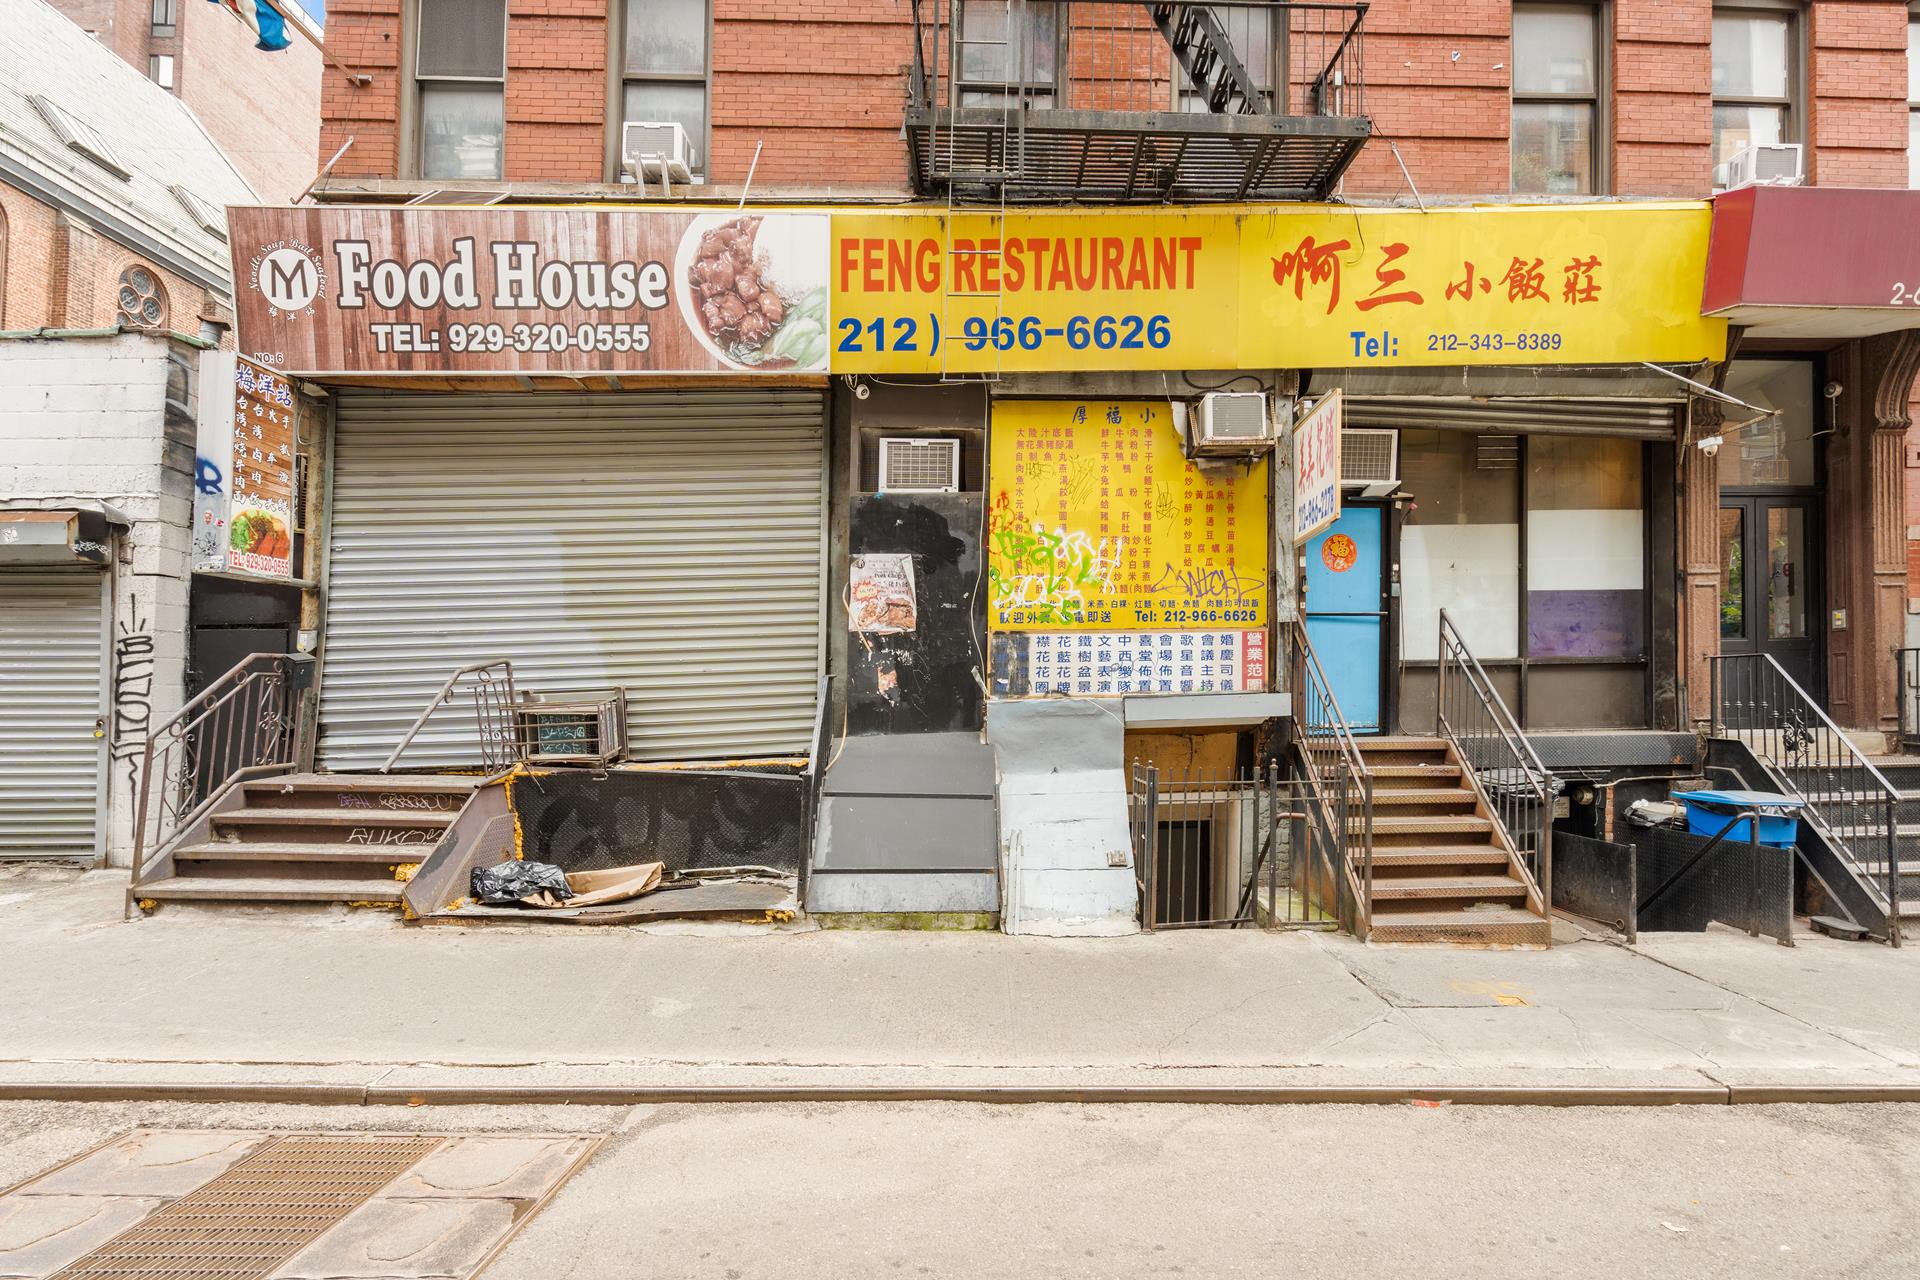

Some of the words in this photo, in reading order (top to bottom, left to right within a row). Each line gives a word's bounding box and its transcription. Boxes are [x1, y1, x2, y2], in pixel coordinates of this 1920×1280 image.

[249, 255, 262, 291] Noodle
[260, 240, 284, 254] Soup
[312, 256, 328, 299] Seafood
[334, 236, 480, 310] Food
[490, 241, 669, 311] House
[840, 238, 941, 293] FENG
[954, 237, 1203, 292] RESTAURANT
[370, 322, 440, 352] TEL:
[448, 322, 650, 353] 929-320-0555
[963, 315, 1171, 351] 966-6626
[1351, 331, 1398, 357] Tel:
[1427, 333, 1561, 352] 212-343-8389
[276, 352, 284, 363] 6
[236, 363, 292, 408] 梅洋站
[1135, 610, 1157, 622] Tel:
[1164, 610, 1257, 622] 212-966-6626
